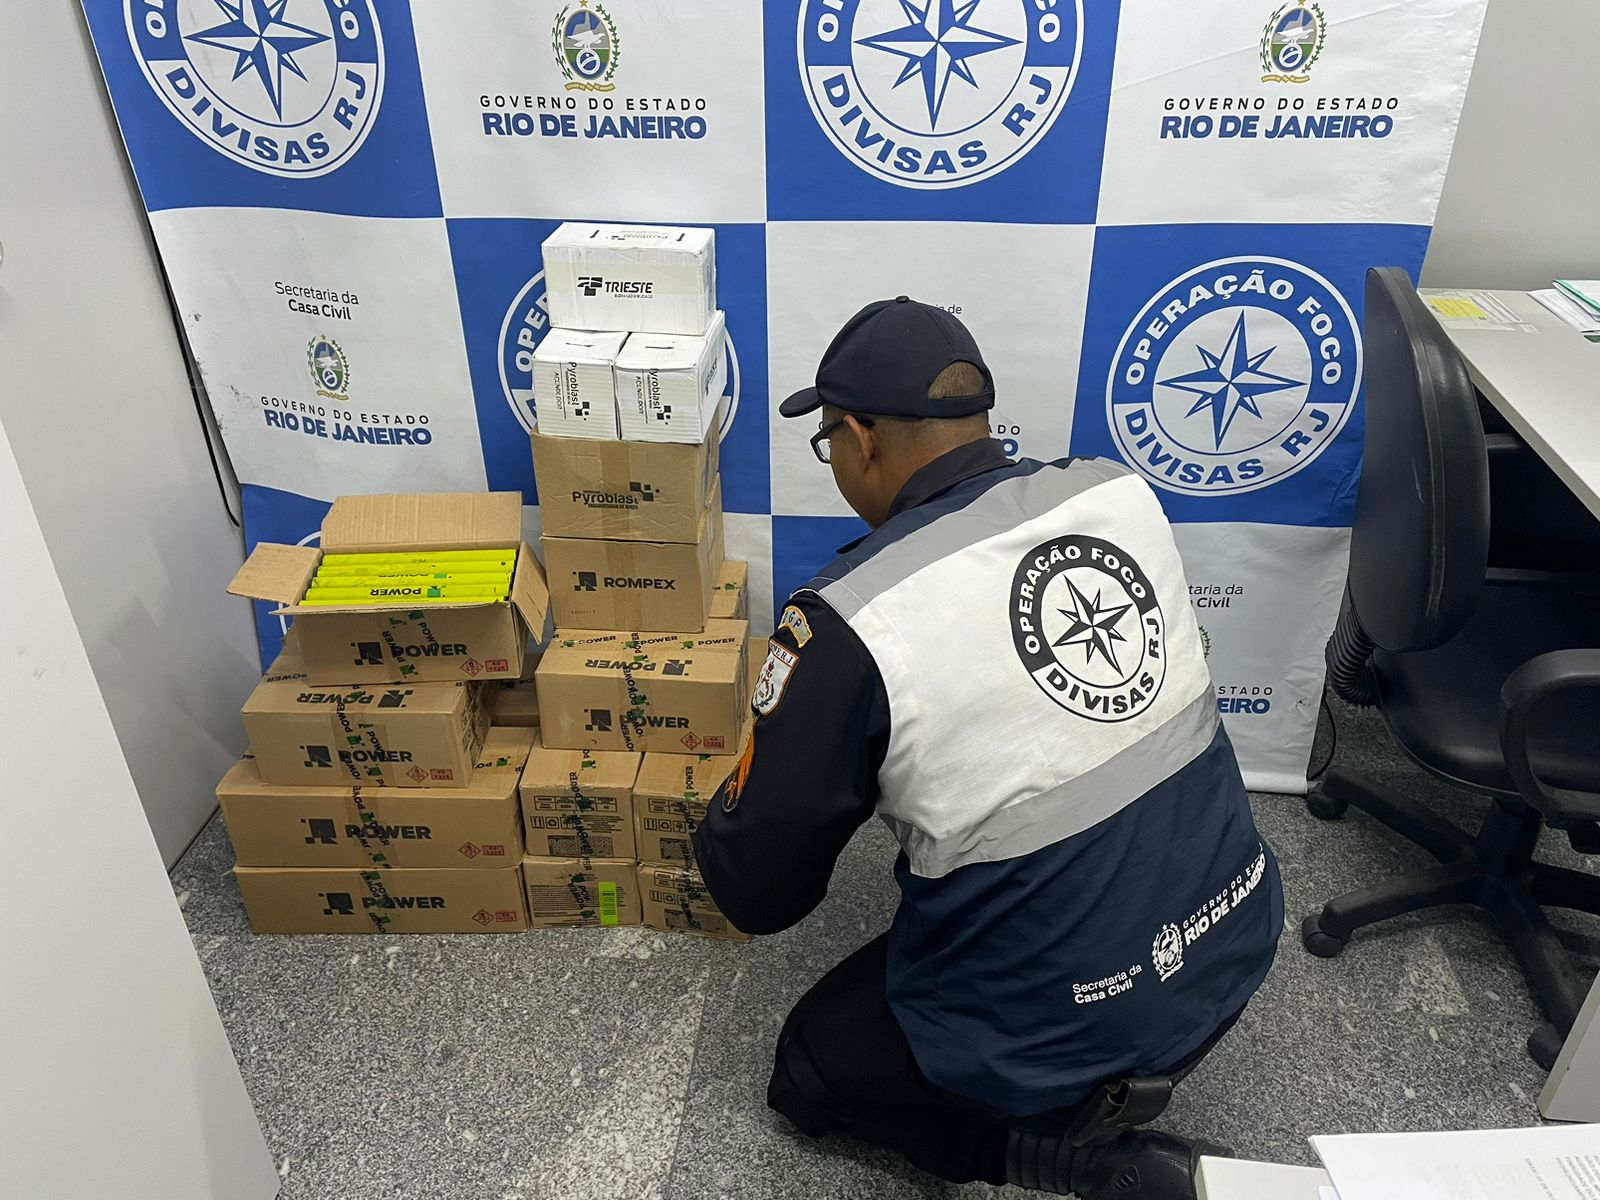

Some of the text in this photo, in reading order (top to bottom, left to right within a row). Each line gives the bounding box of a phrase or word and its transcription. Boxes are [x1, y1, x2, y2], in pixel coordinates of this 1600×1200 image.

[480, 95, 707, 111] GOVERNO DO ESTADO
[1164, 97, 1399, 110] GOVERNO DO ESTADO
[166, 67, 366, 164] DIVISAS RJ
[822, 73, 1052, 175] DIVISAS RJ
[482, 113, 707, 139] RIO DE JANEIRO
[1160, 115, 1394, 138] RIO DE JANEIRO
[274, 281, 359, 305] Secretaria da
[605, 281, 653, 293] TRIESTE
[288, 299, 352, 320] Casa Civil
[1126, 269, 1342, 386] OPERAÇÃO FOCO
[567, 361, 579, 406] Pyroblast
[261, 396, 429, 424] GOVERNO DO ESTADO
[264, 409, 432, 445] RIO DE JANEIRO
[1125, 408, 1330, 485] DIVISAS RJ
[572, 490, 639, 505] Pyroblast
[370, 588, 422, 596] POWER
[603, 577, 676, 590] ROMPEX
[1188, 584, 1244, 595] taria da
[1018, 544, 1146, 655] OPERAÇÃO FOCO
[1196, 597, 1231, 608] Civil
[640, 635, 679, 645] POWER
[698, 637, 736, 646] POWER
[1146, 618, 1160, 659] RJ
[391, 643, 468, 658] POWER
[585, 659, 657, 671] POWER
[266, 672, 308, 683] POWER
[296, 693, 375, 704] POWER
[1046, 668, 1155, 714] DIVISAS
[1218, 686, 1273, 695] STADO
[1216, 698, 1271, 714] EIRO
[338, 751, 413, 762] POWER
[345, 824, 432, 839] POWER
[361, 897, 446, 909] POWER
[1183, 889, 1228, 929] GOVERNO
[1231, 875, 1242, 889] DO
[1184, 852, 1266, 946] RIO DE JANEIRO
[1072, 964, 1143, 994] Secretaria da
[1074, 980, 1134, 1004] Casa Civil
